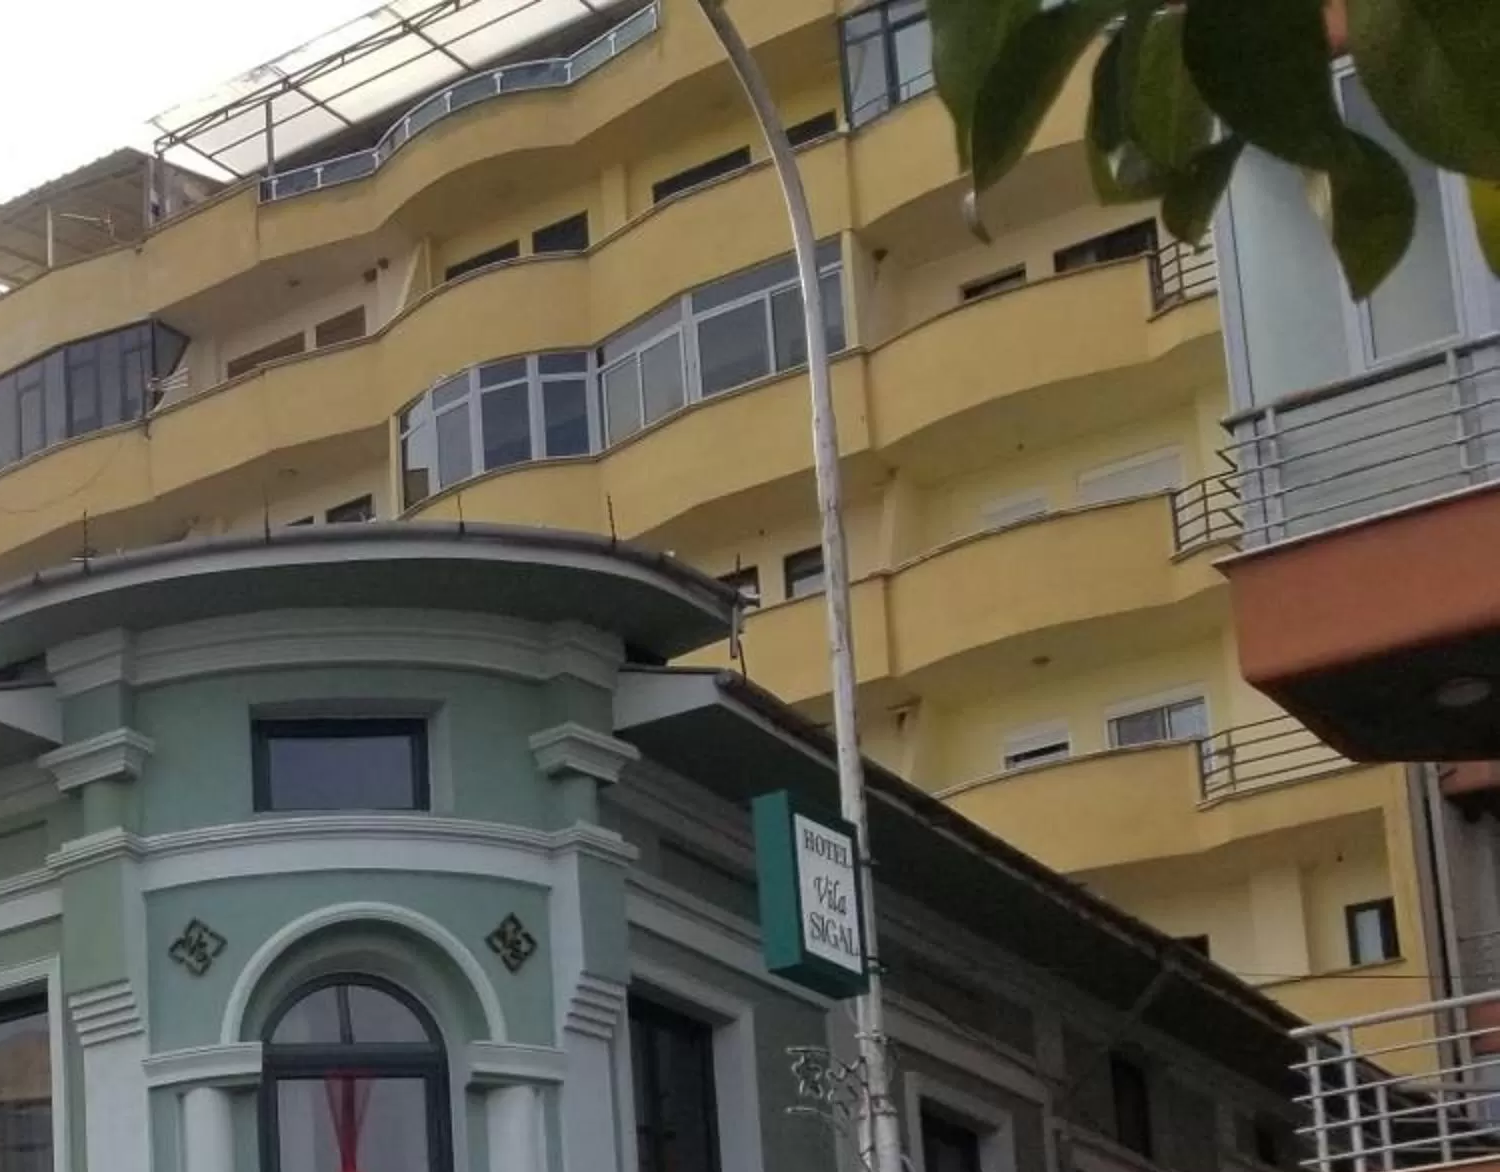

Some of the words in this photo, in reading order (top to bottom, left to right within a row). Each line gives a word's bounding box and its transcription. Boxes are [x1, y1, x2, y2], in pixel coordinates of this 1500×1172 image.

[803, 828, 853, 869] HOTEL
[813, 875, 848, 915] Vila
[808, 911, 861, 957] SIGAL
